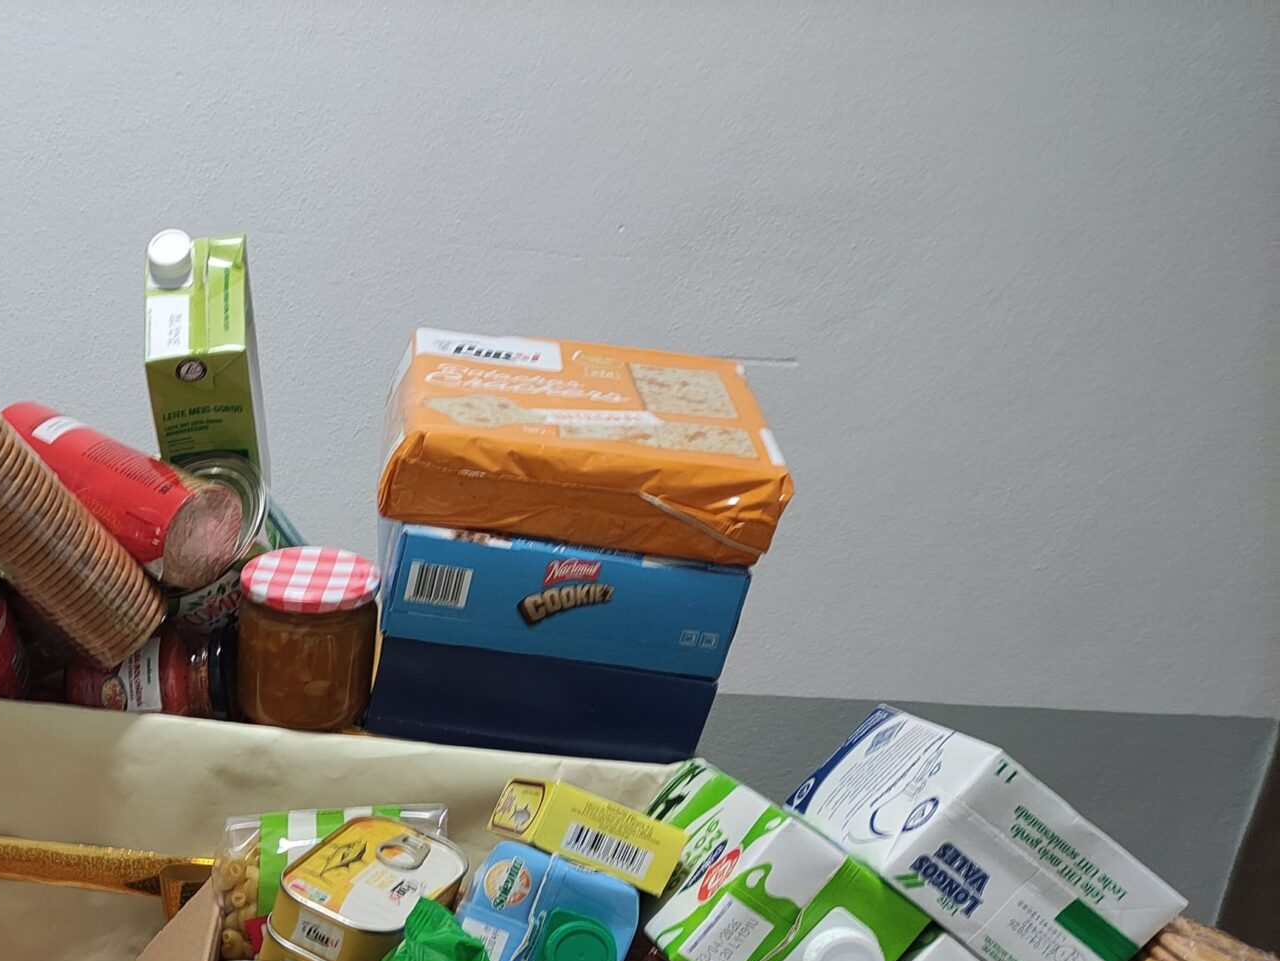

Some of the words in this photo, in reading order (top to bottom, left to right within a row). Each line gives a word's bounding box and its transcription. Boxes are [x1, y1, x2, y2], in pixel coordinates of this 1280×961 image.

[545, 557, 602, 584] Nacional
[910, 854, 983, 919] LONGOS
[933, 842, 991, 896] VALES
